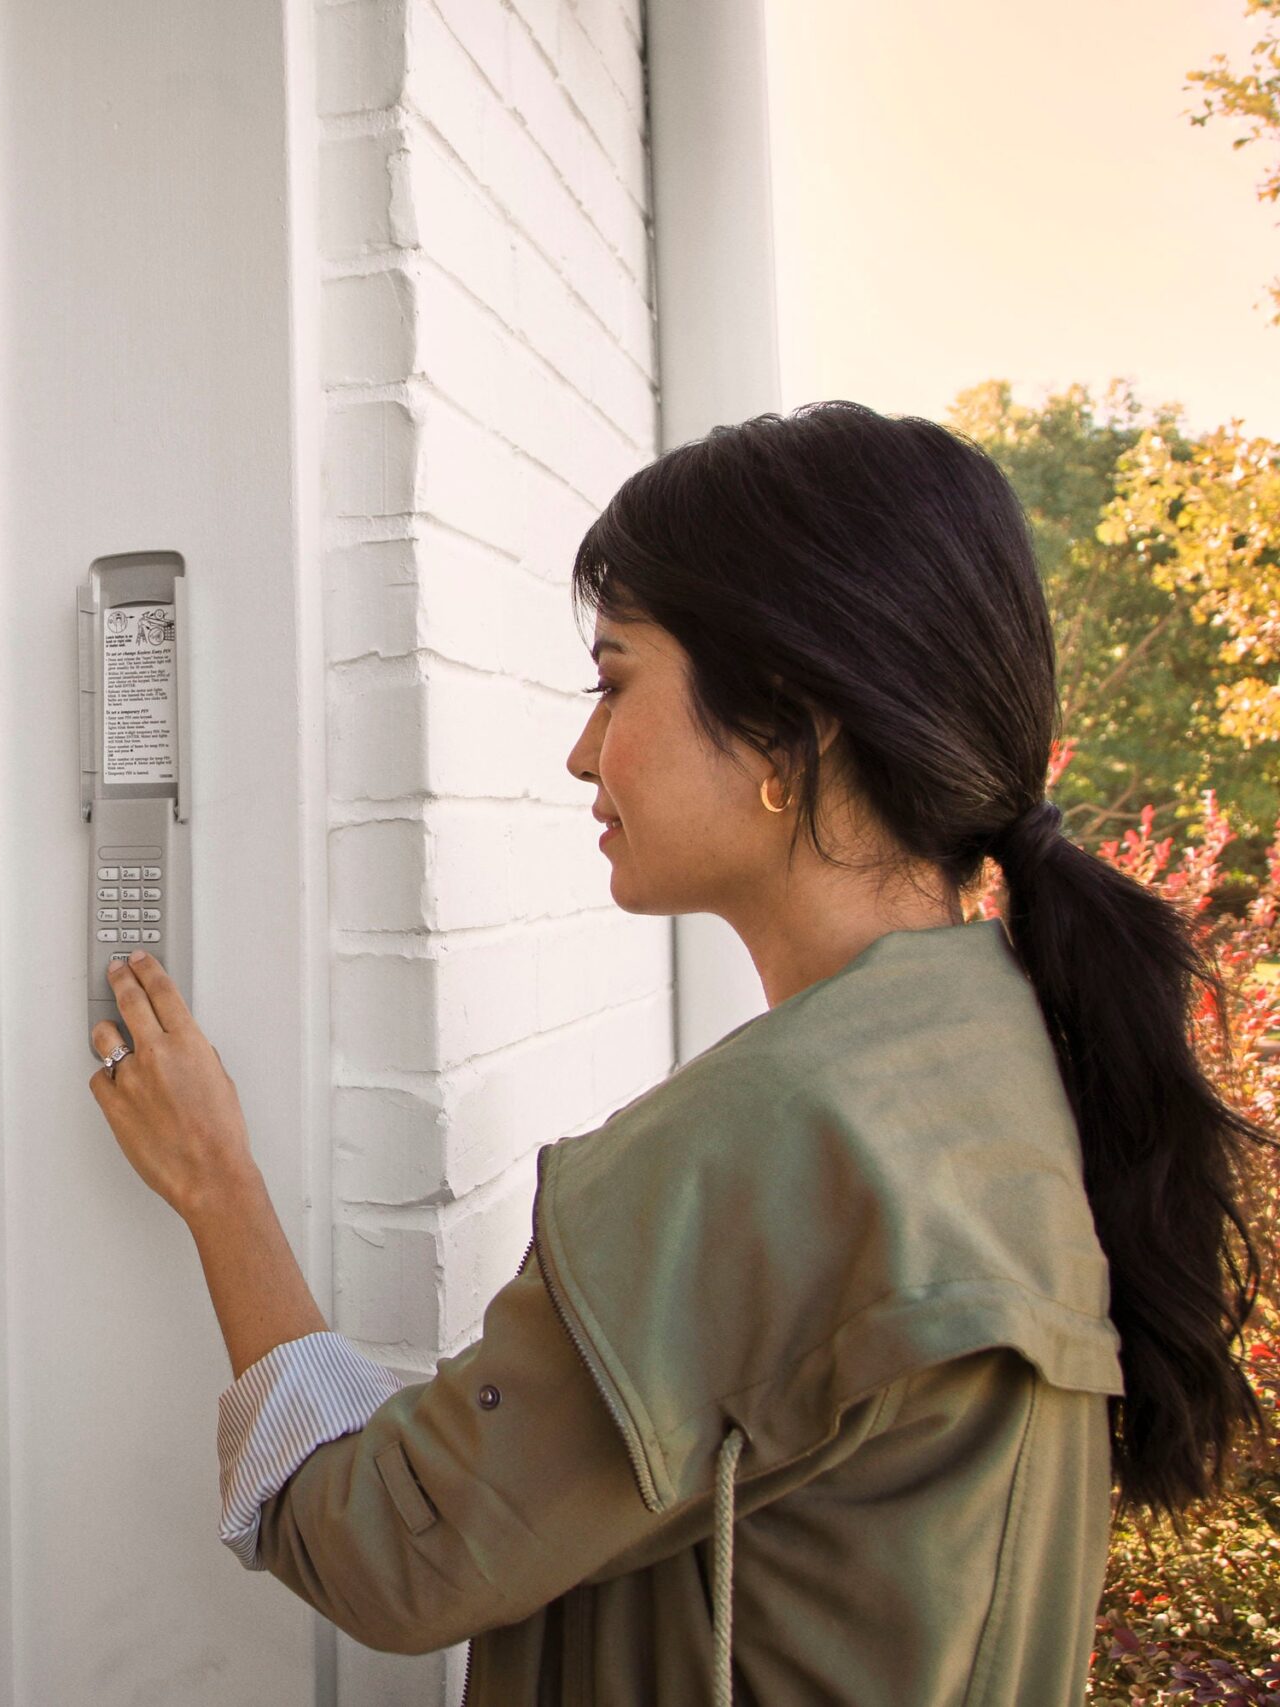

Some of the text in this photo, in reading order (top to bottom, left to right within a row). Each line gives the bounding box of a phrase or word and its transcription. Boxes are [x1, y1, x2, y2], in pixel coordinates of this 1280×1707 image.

[100, 890, 104, 898] 4
[123, 890, 128, 898] 5
[144, 911, 148, 919] 9
